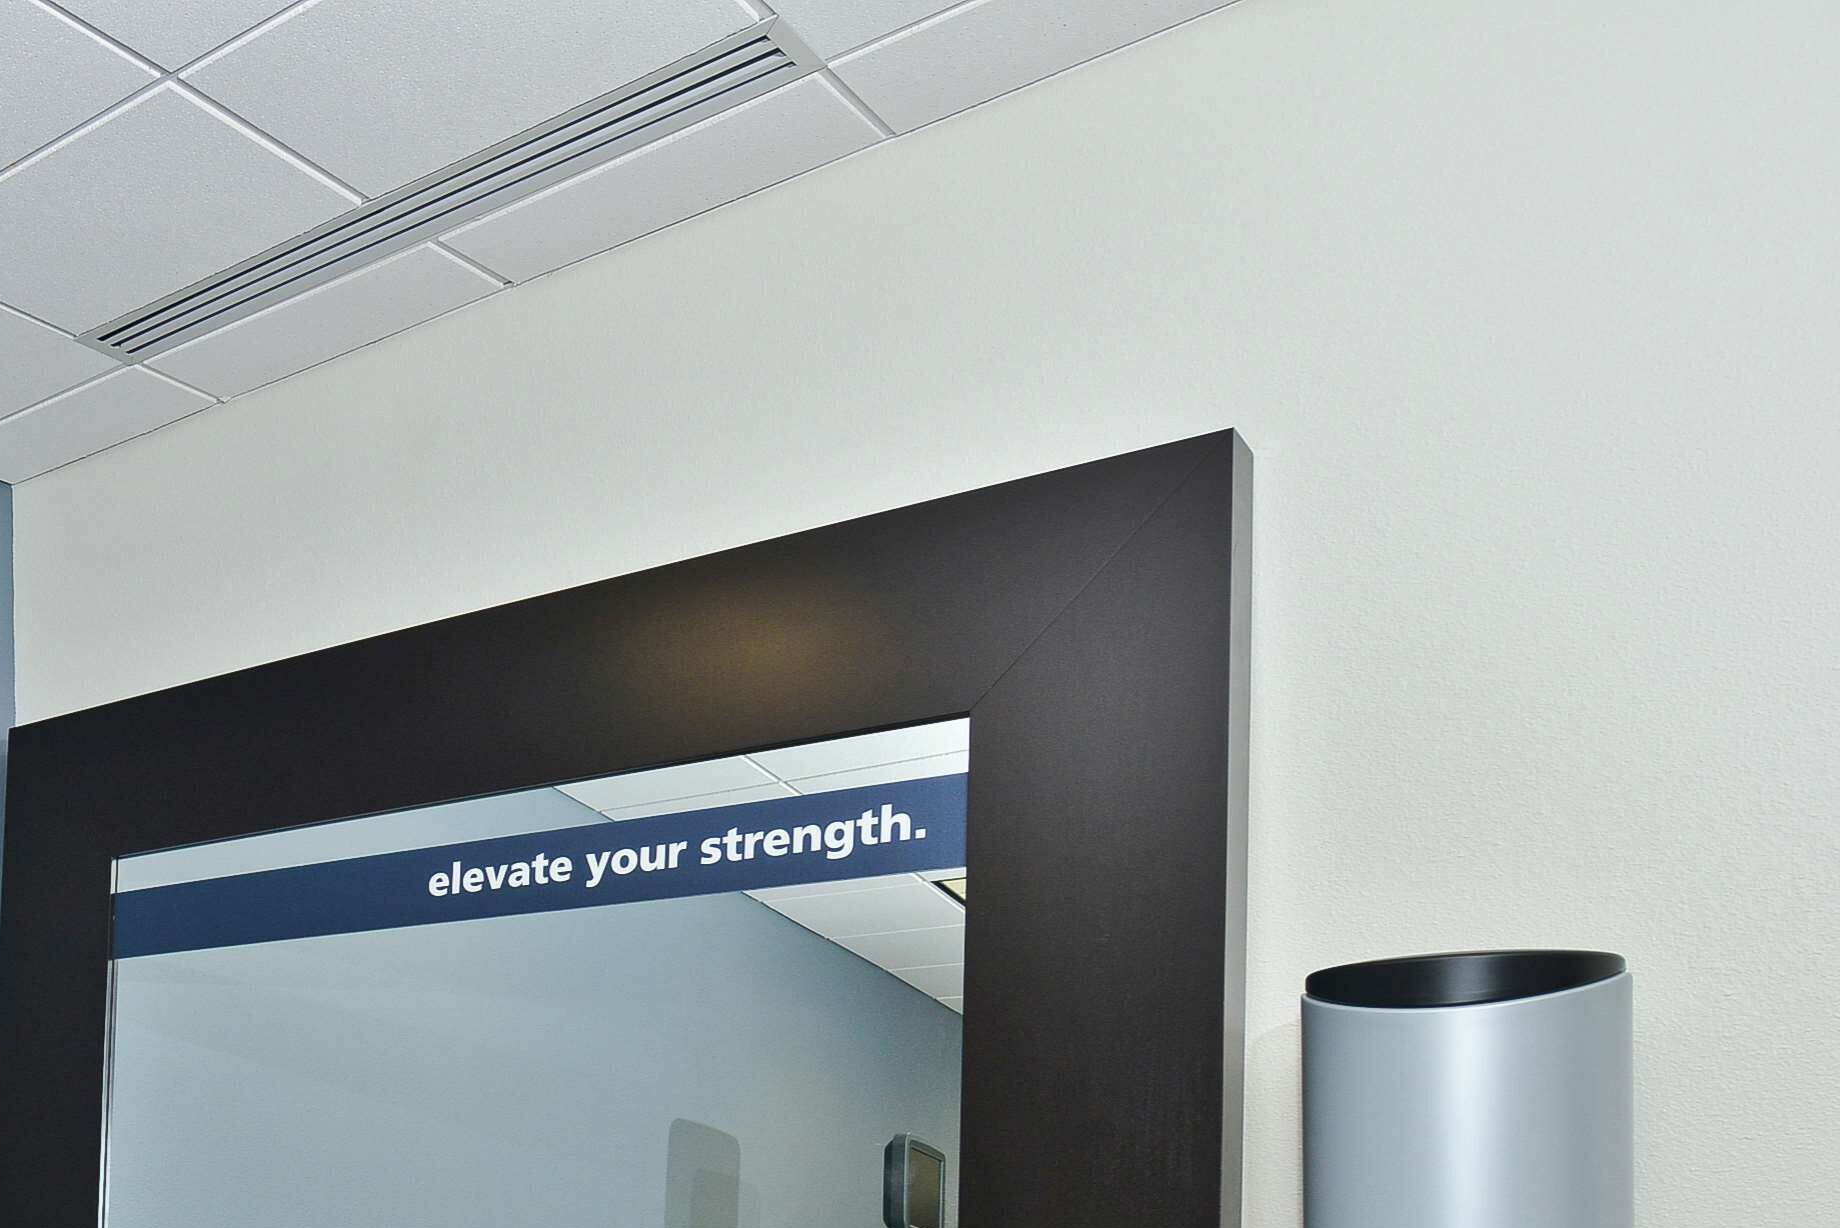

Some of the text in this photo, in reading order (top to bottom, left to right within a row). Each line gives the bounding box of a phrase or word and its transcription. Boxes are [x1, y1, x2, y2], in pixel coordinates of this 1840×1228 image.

[428, 803, 927, 897] elevate your strength.
